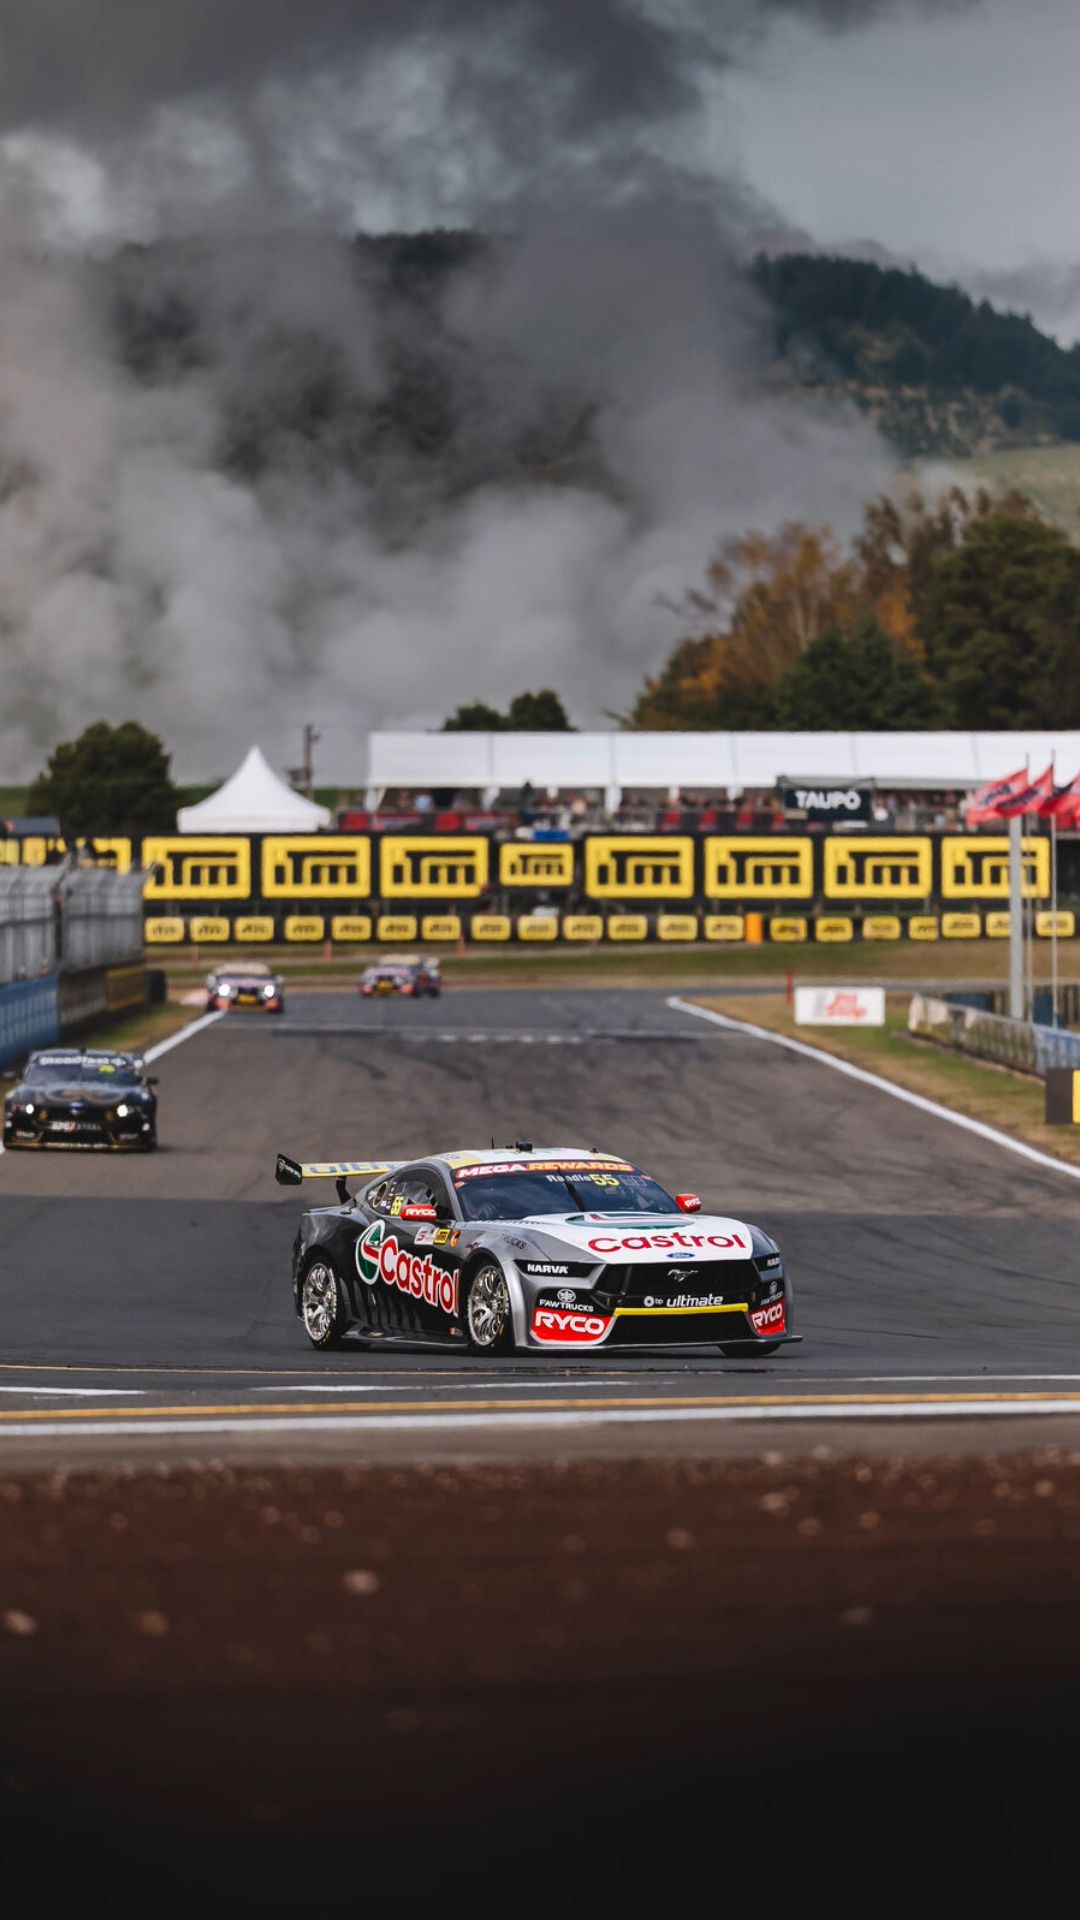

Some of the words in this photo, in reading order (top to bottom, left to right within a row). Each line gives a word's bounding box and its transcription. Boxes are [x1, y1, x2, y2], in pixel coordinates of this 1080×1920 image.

[528, 1161, 634, 1172] REWARDS
[590, 1174, 620, 1186] 55
[587, 1232, 747, 1253] Castrol
[527, 1263, 569, 1274] NARVA
[380, 1236, 459, 1318] Castrol
[539, 1299, 560, 1308] FAW
[560, 1301, 594, 1312] TRUCKS
[666, 1293, 724, 1307] ultimate
[535, 1311, 605, 1335] RYCO
[752, 1303, 783, 1329] RYCO
